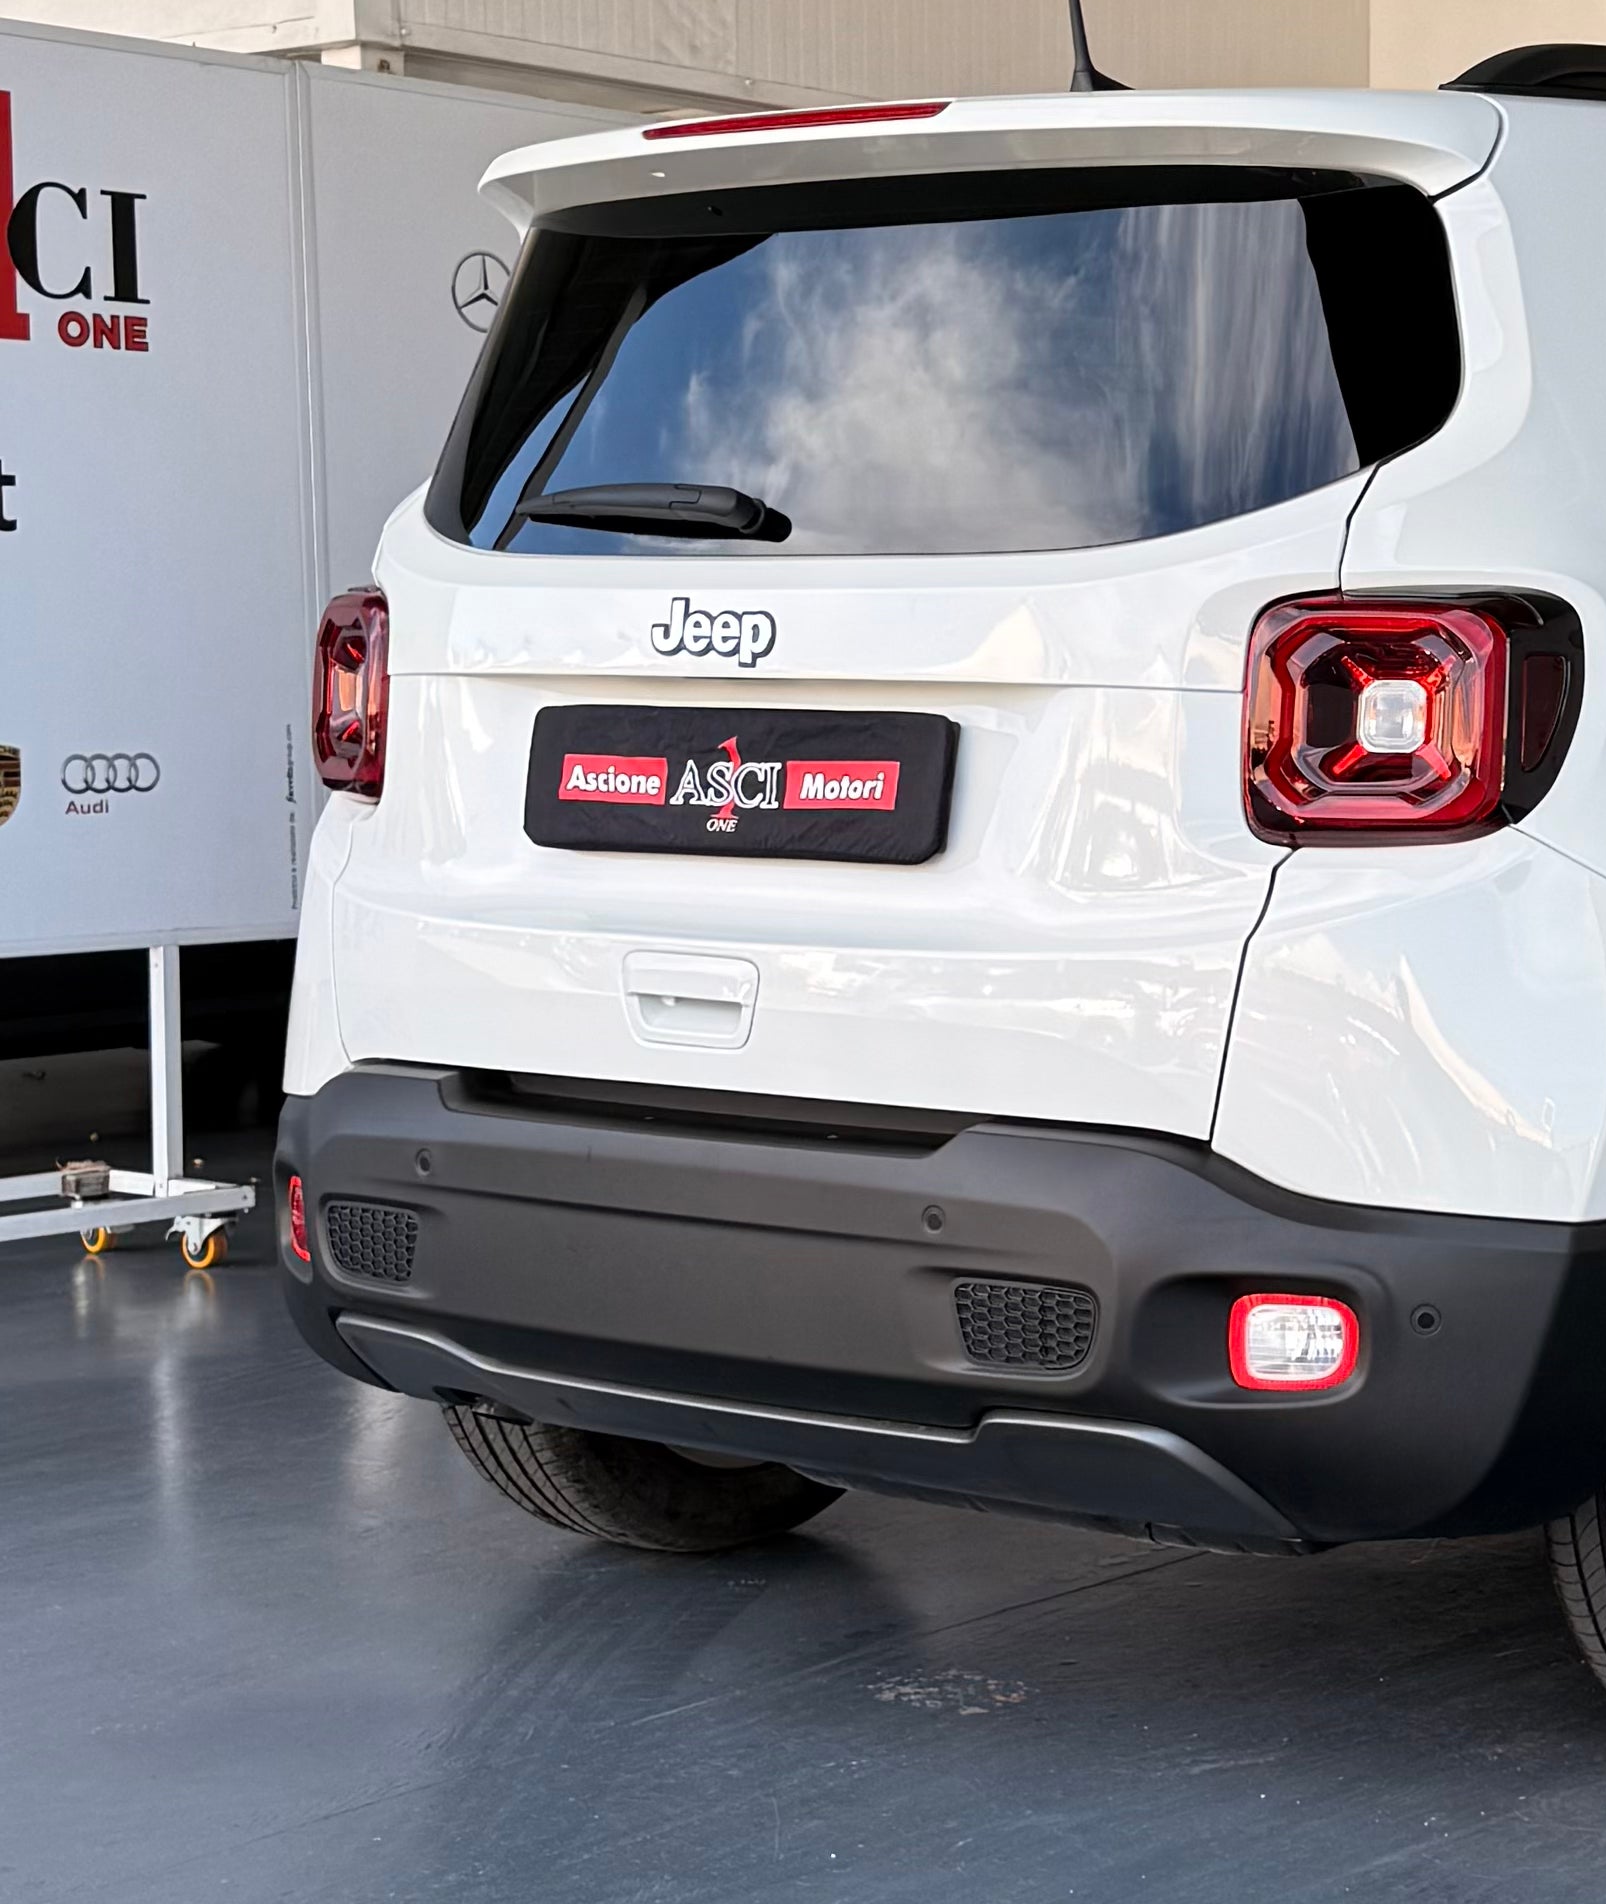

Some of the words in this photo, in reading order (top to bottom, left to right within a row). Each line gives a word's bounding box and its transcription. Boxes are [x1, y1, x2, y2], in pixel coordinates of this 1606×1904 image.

[58, 311, 149, 352] ONE
[651, 597, 776, 667] Jeep
[565, 764, 662, 796] Ascione
[669, 759, 781, 810] ASCI
[799, 772, 885, 800] Motori
[65, 799, 109, 815] Audi
[706, 818, 739, 833] ONE
